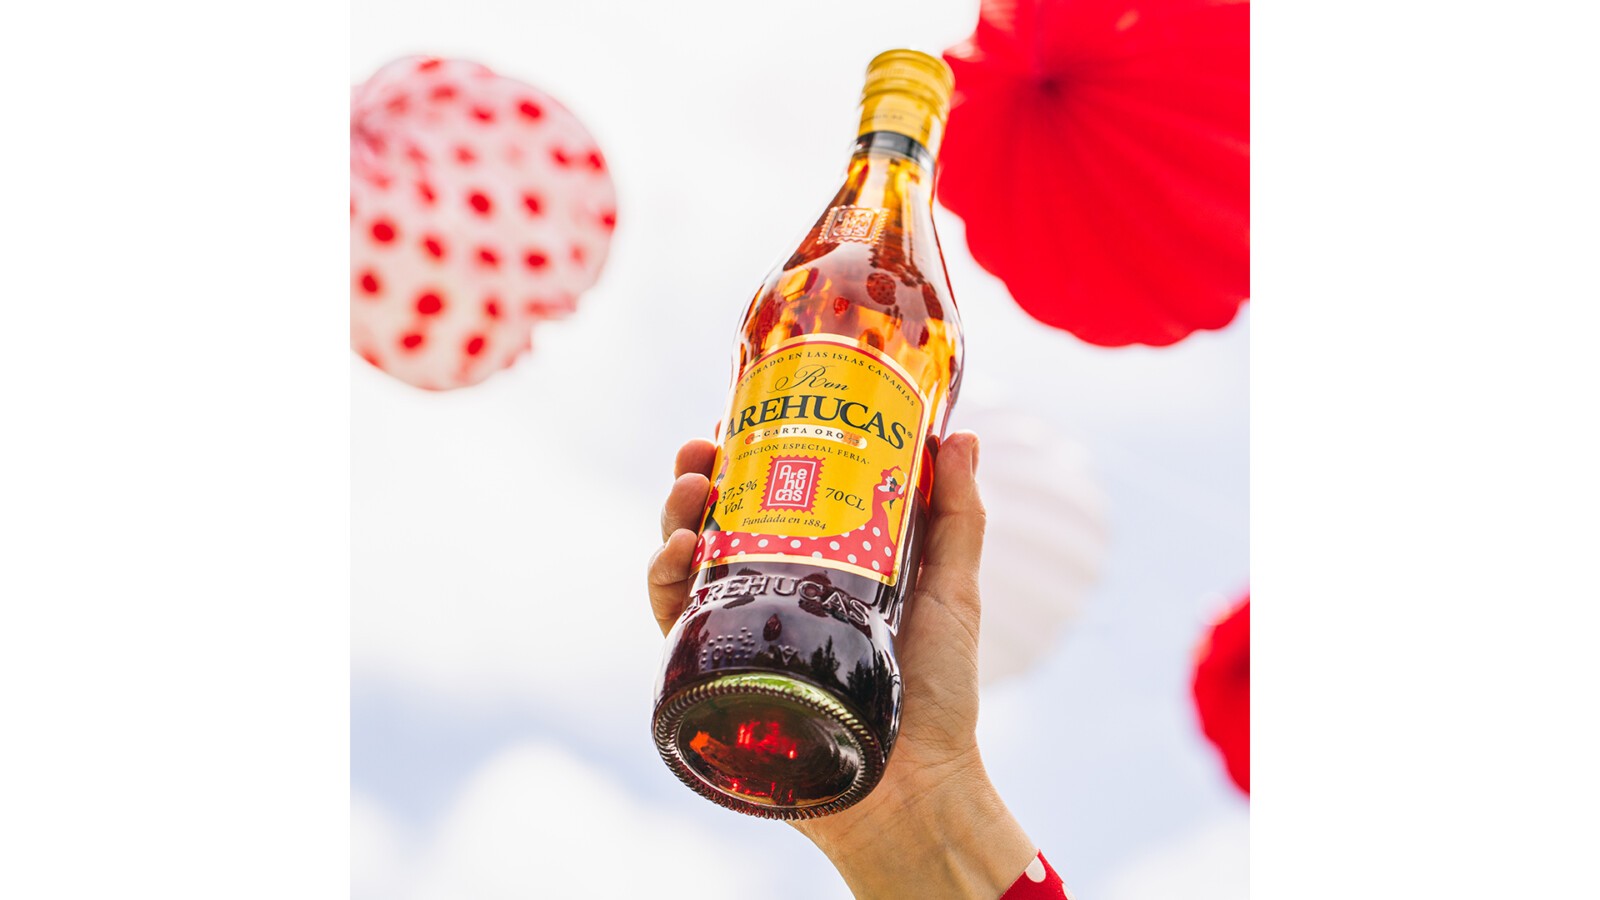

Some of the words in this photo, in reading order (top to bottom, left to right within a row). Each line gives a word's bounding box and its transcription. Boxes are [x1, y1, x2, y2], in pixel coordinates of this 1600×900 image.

[766, 364, 849, 394] Ron
[788, 352, 803, 361] EN
[832, 352, 864, 366] ISLAS
[867, 364, 915, 406] CANARIAS
[814, 428, 844, 440] ORO
[782, 442, 834, 454] ESPECIAL
[719, 479, 758, 505] 37,5%
[825, 487, 866, 511] 70CL
[724, 499, 744, 516] Vol.
[741, 514, 786, 528] Fundada
[788, 516, 801, 524] en
[803, 517, 827, 531] 1884
